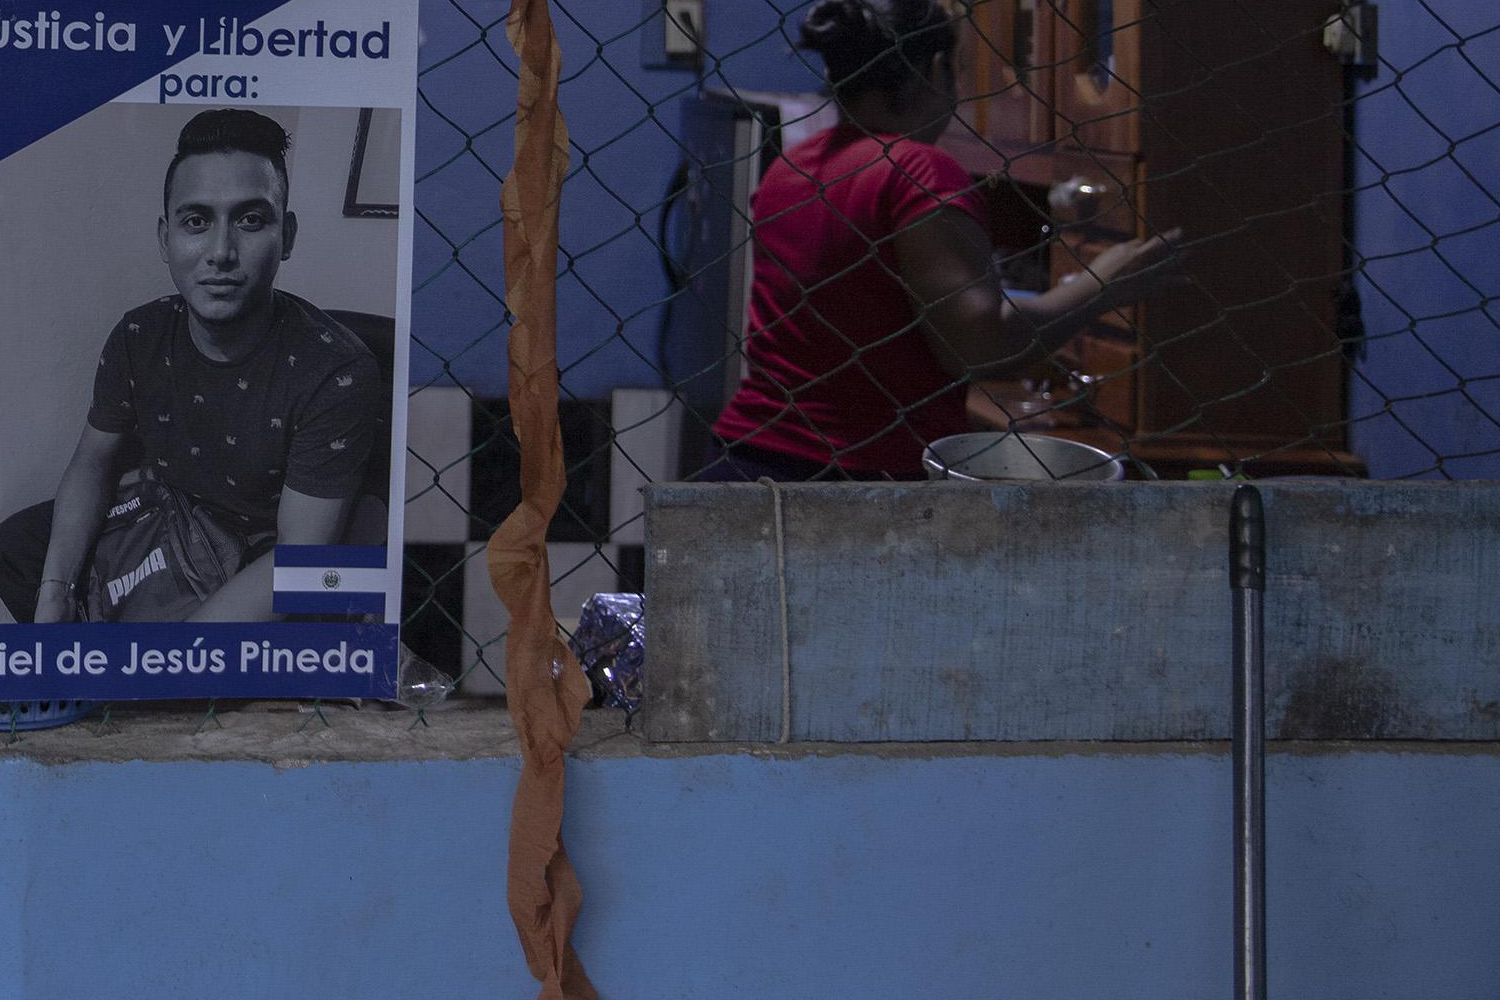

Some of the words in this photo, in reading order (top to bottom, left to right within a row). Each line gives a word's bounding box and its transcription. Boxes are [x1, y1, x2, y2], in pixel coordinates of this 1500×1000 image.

[162, 22, 186, 56] y
[201, 16, 389, 60] Libertad
[159, 70, 259, 104] para:
[107, 547, 167, 606] PUMA
[55, 640, 108, 675] de
[120, 637, 226, 675] Jesús
[240, 639, 375, 675] Pineda
